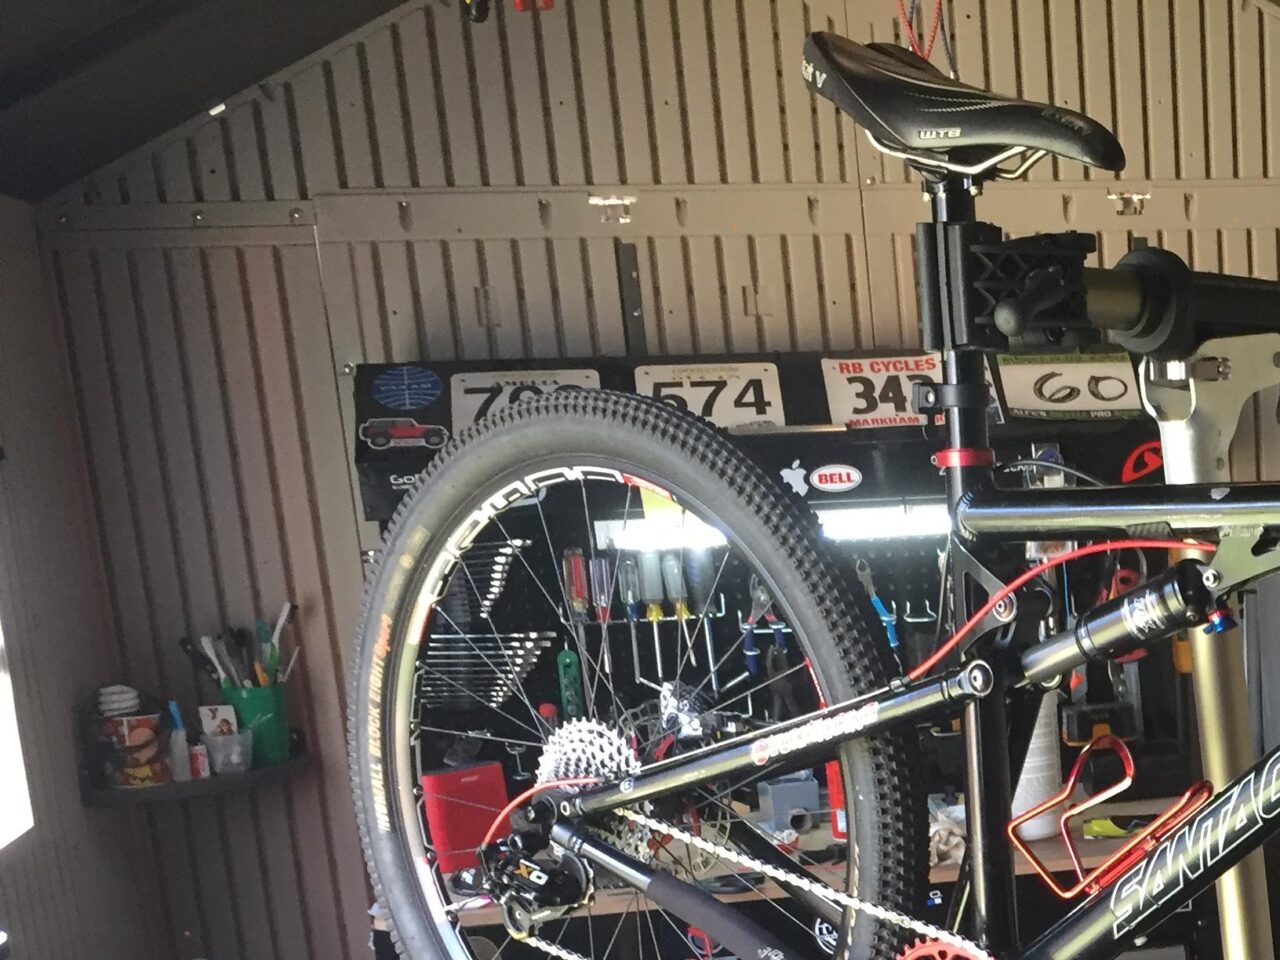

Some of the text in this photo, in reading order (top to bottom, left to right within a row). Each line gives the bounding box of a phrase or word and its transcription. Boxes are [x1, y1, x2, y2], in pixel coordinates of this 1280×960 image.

[919, 127, 961, 139] WTB
[838, 357, 937, 374] RB CYCLES
[652, 378, 772, 418] 574
[1033, 371, 1128, 404] 60
[848, 416, 920, 427] MARKHAM
[817, 472, 856, 485] BELL
[369, 656, 385, 702] EIGHT
[368, 706, 382, 758] BLOCK
